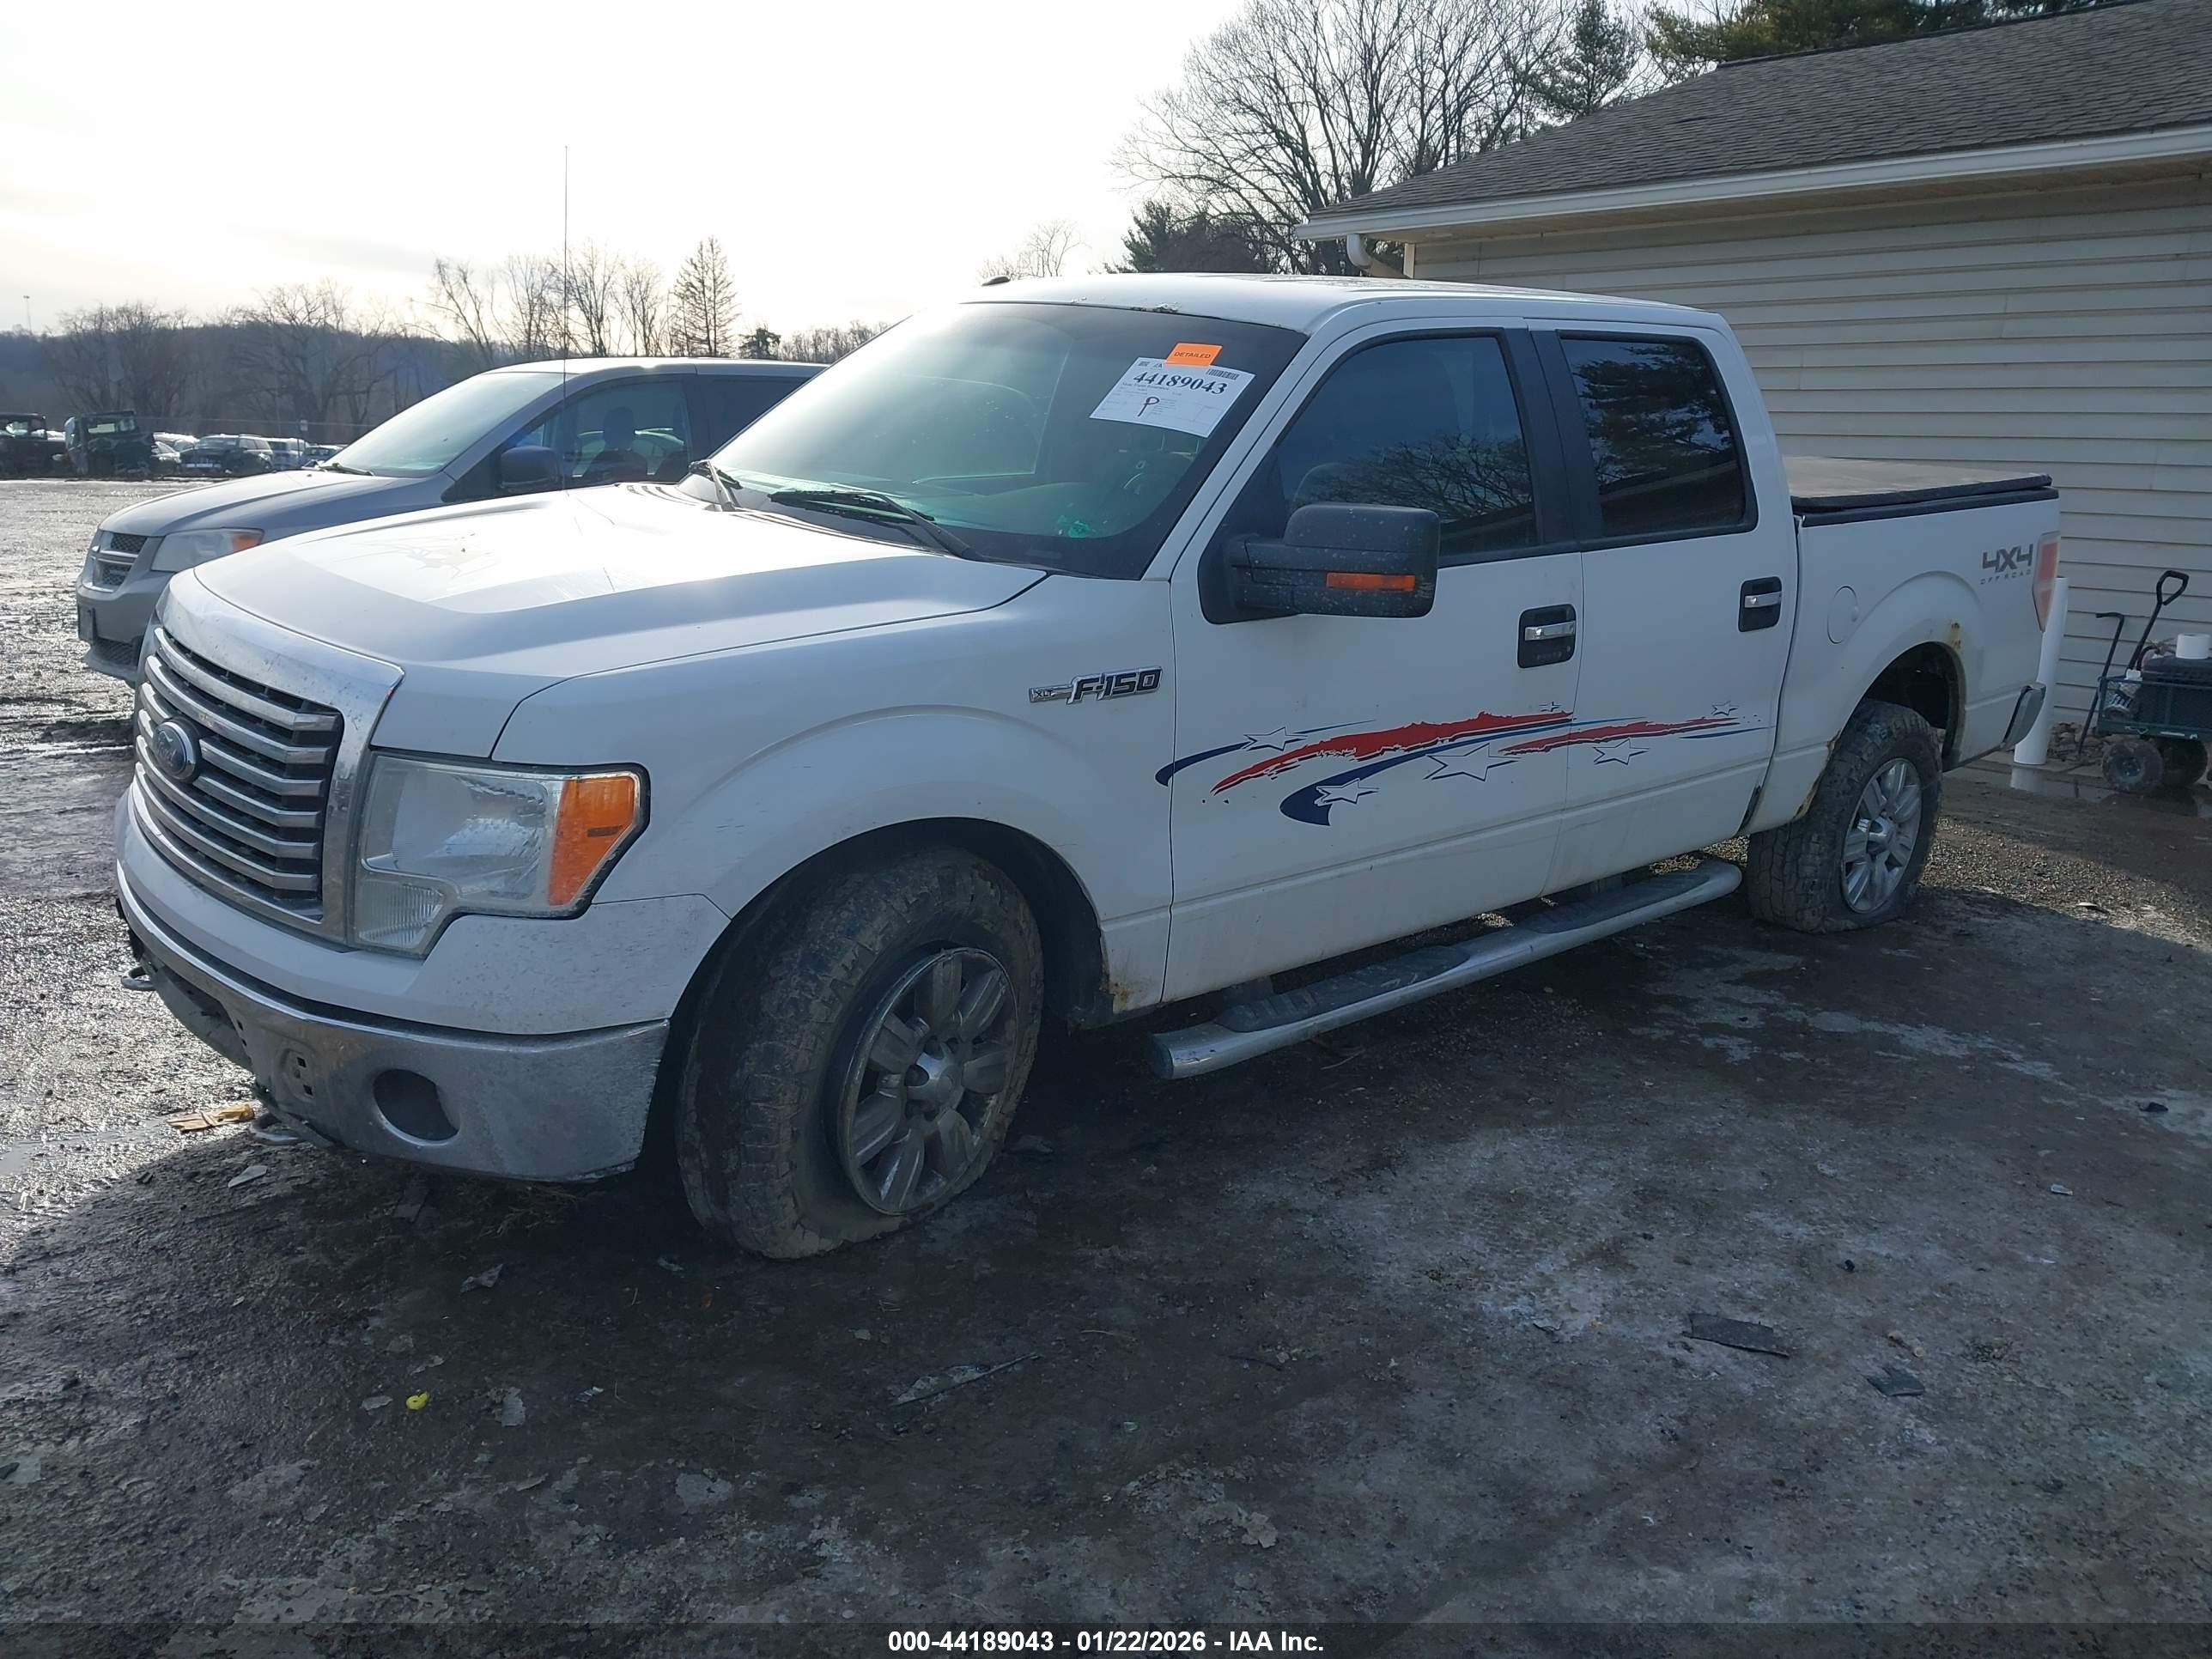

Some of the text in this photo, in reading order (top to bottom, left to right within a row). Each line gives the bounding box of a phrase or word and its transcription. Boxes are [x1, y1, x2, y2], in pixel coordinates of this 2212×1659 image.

[1173, 350, 1212, 360] DETAILED
[1133, 371, 1228, 396] 44189043
[1136, 396, 1160, 417] P
[1035, 688, 1054, 698] XLT
